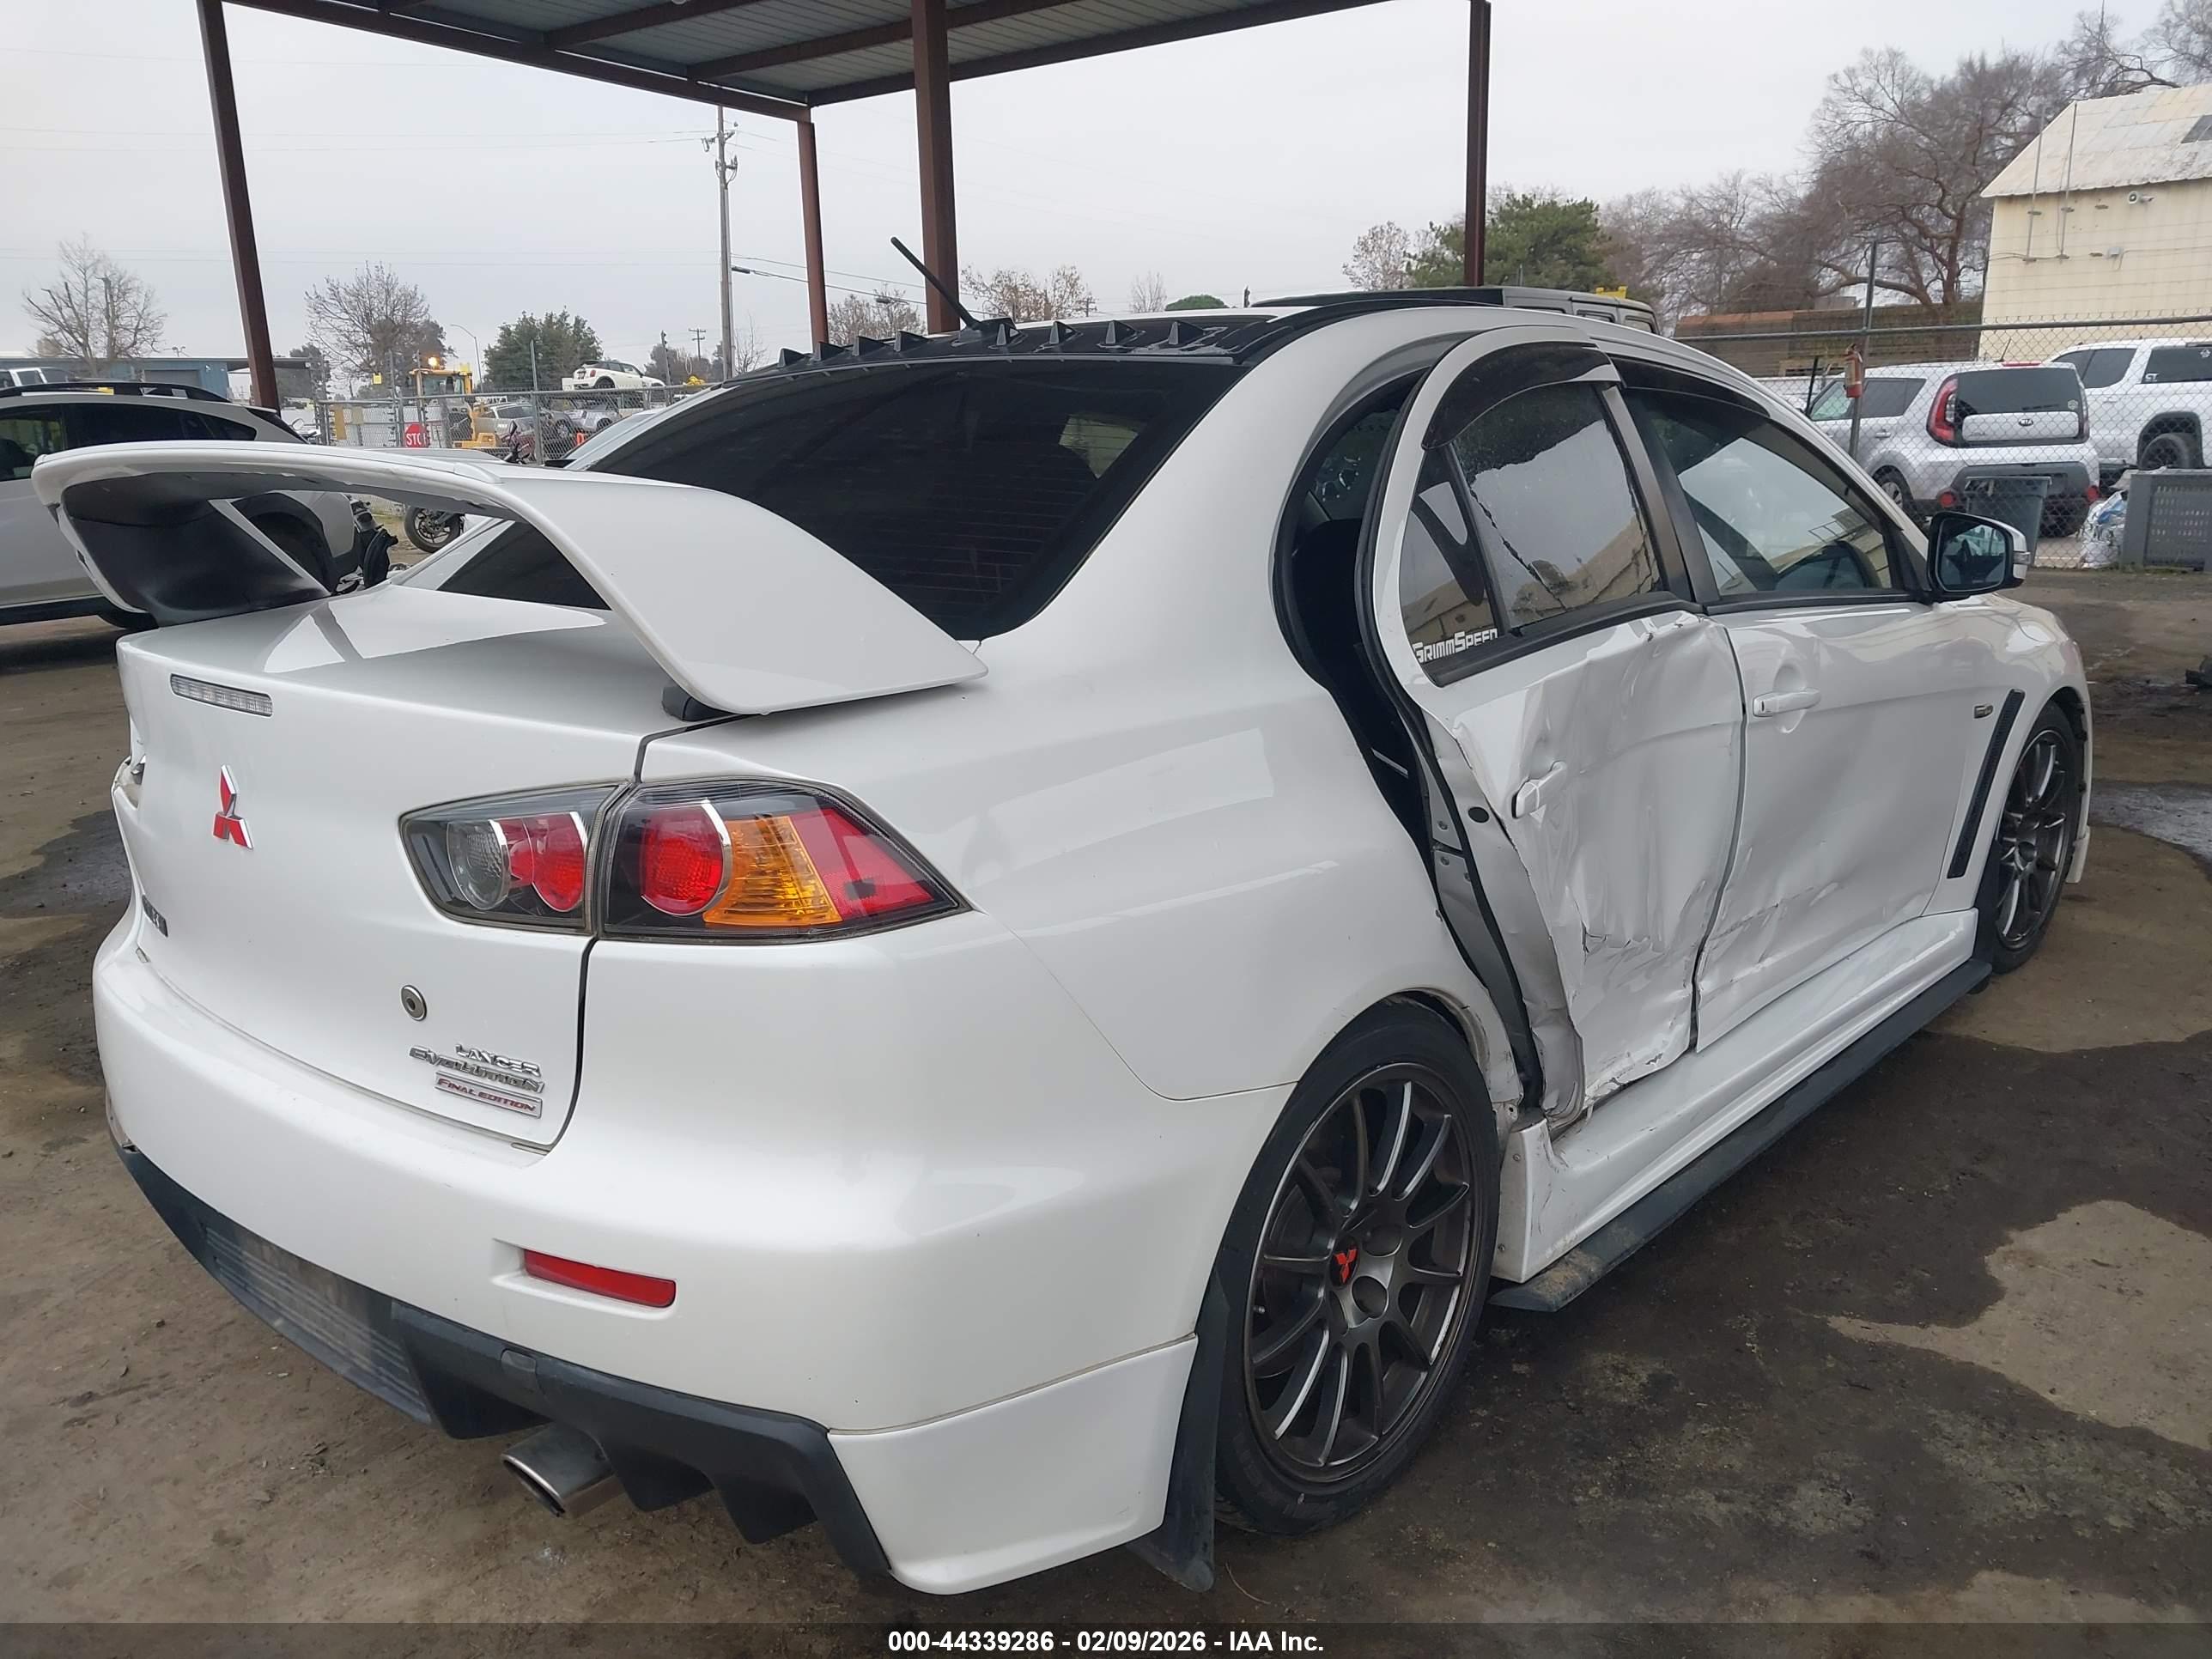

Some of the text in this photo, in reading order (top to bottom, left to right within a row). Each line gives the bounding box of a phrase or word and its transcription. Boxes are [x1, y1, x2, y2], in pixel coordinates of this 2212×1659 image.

[406, 433, 425, 445] STO
[409, 1044, 545, 1093] EVOLUTION
[454, 1043, 542, 1077] LANCER
[437, 1078, 536, 1112] FINAL EDITION
